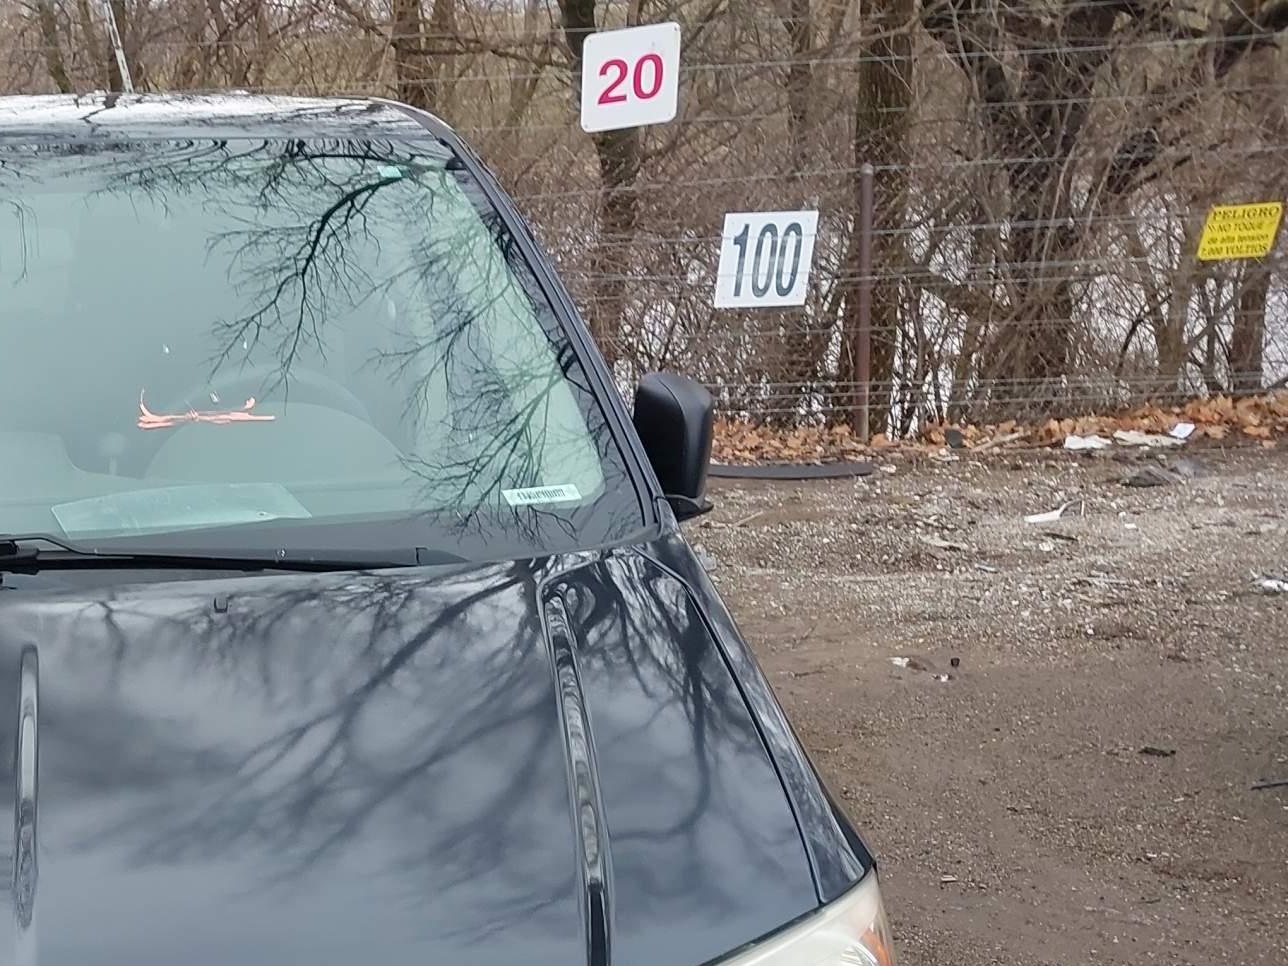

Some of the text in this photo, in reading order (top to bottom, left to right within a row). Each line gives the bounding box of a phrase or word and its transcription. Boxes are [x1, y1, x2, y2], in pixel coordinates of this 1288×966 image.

[597, 53, 664, 105] 20
[1213, 206, 1280, 221] PELIGRO
[732, 222, 803, 298] 100
